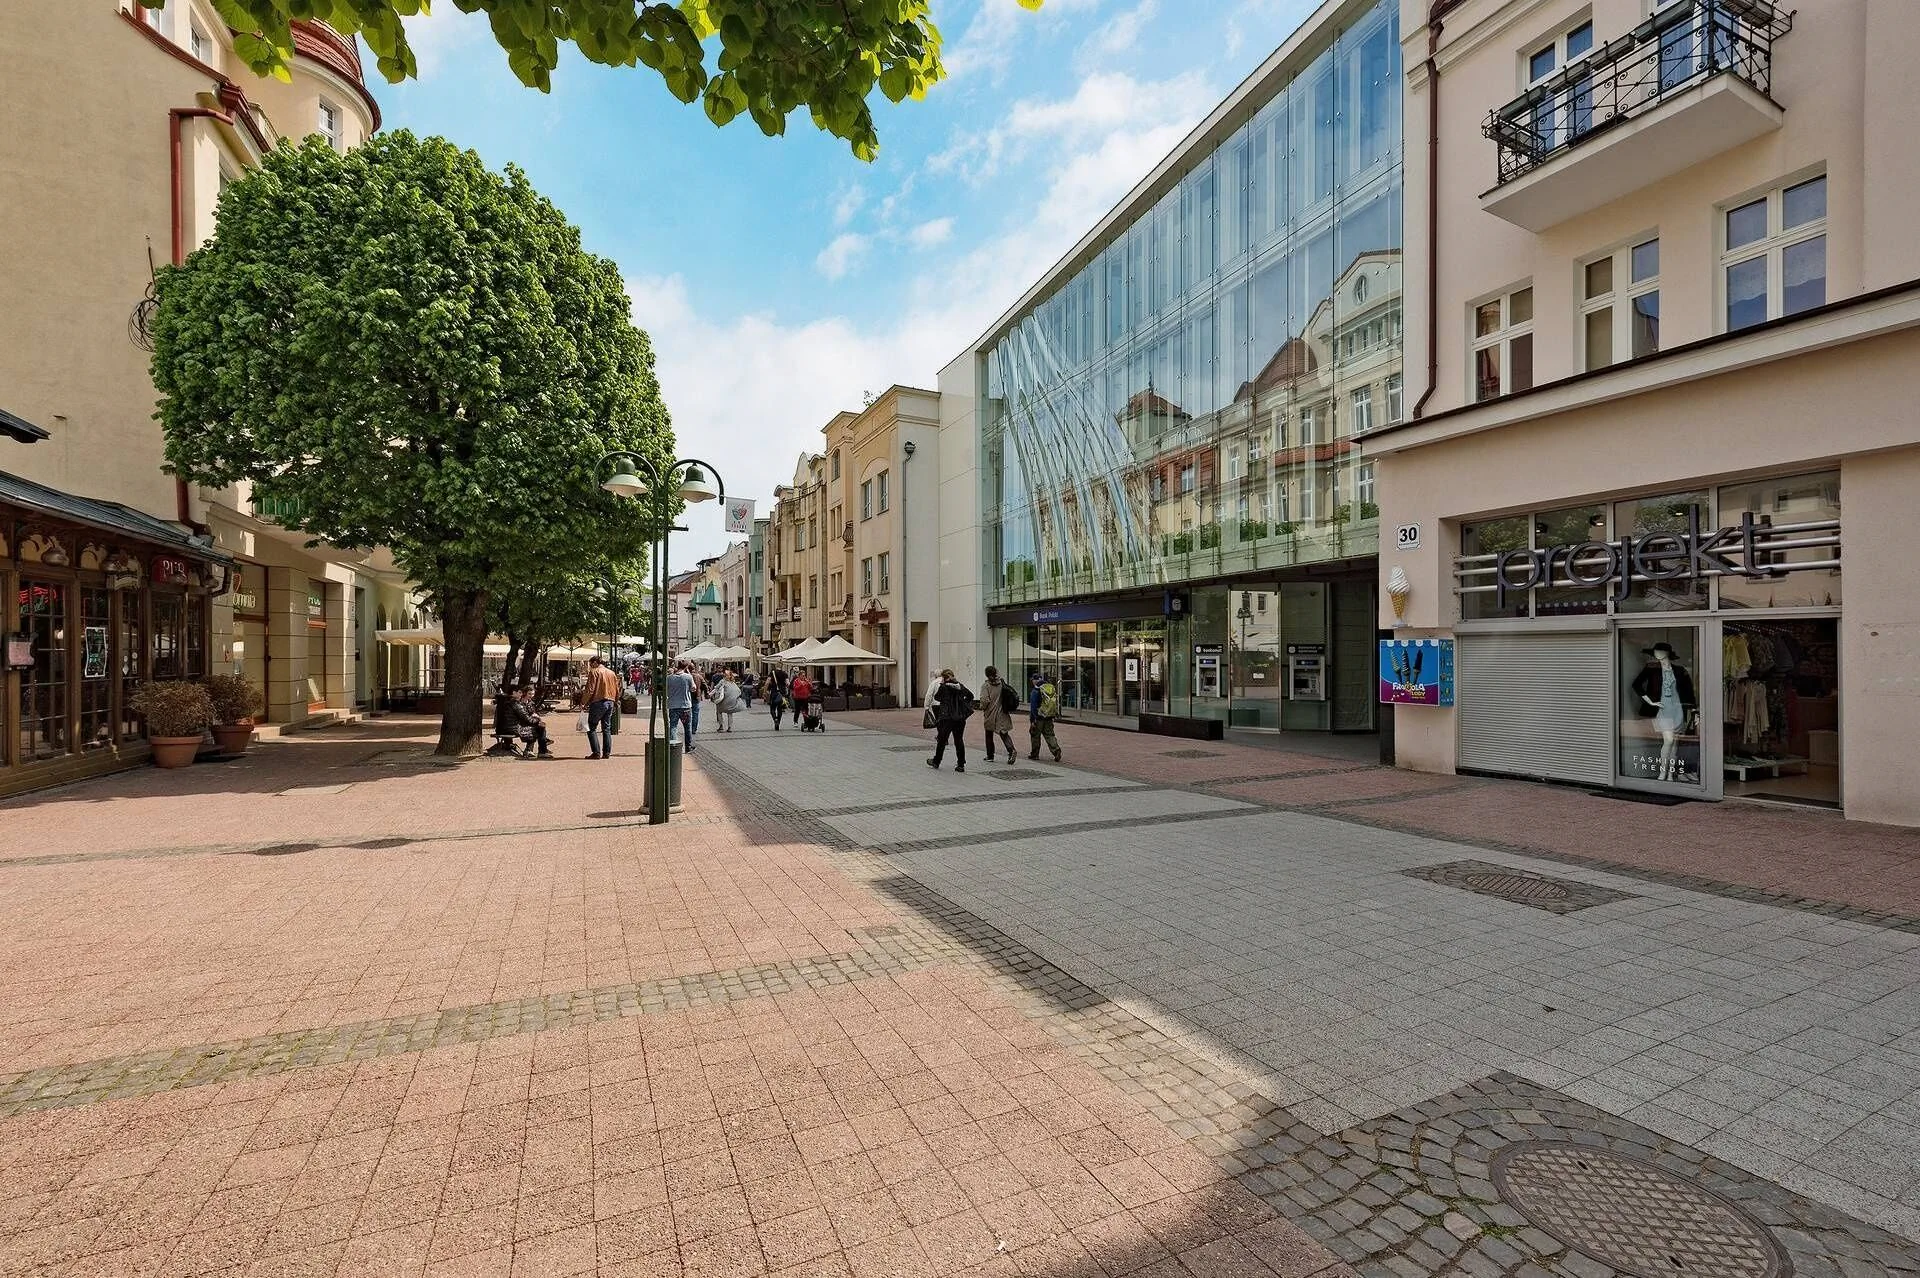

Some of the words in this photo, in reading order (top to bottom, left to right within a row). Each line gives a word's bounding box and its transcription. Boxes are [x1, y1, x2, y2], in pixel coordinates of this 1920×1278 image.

[1400, 527, 1418, 543] 30
[1496, 503, 1773, 609] projekt
[1632, 755, 1685, 766] FASHION
[1632, 762, 1685, 774] TRENDS
